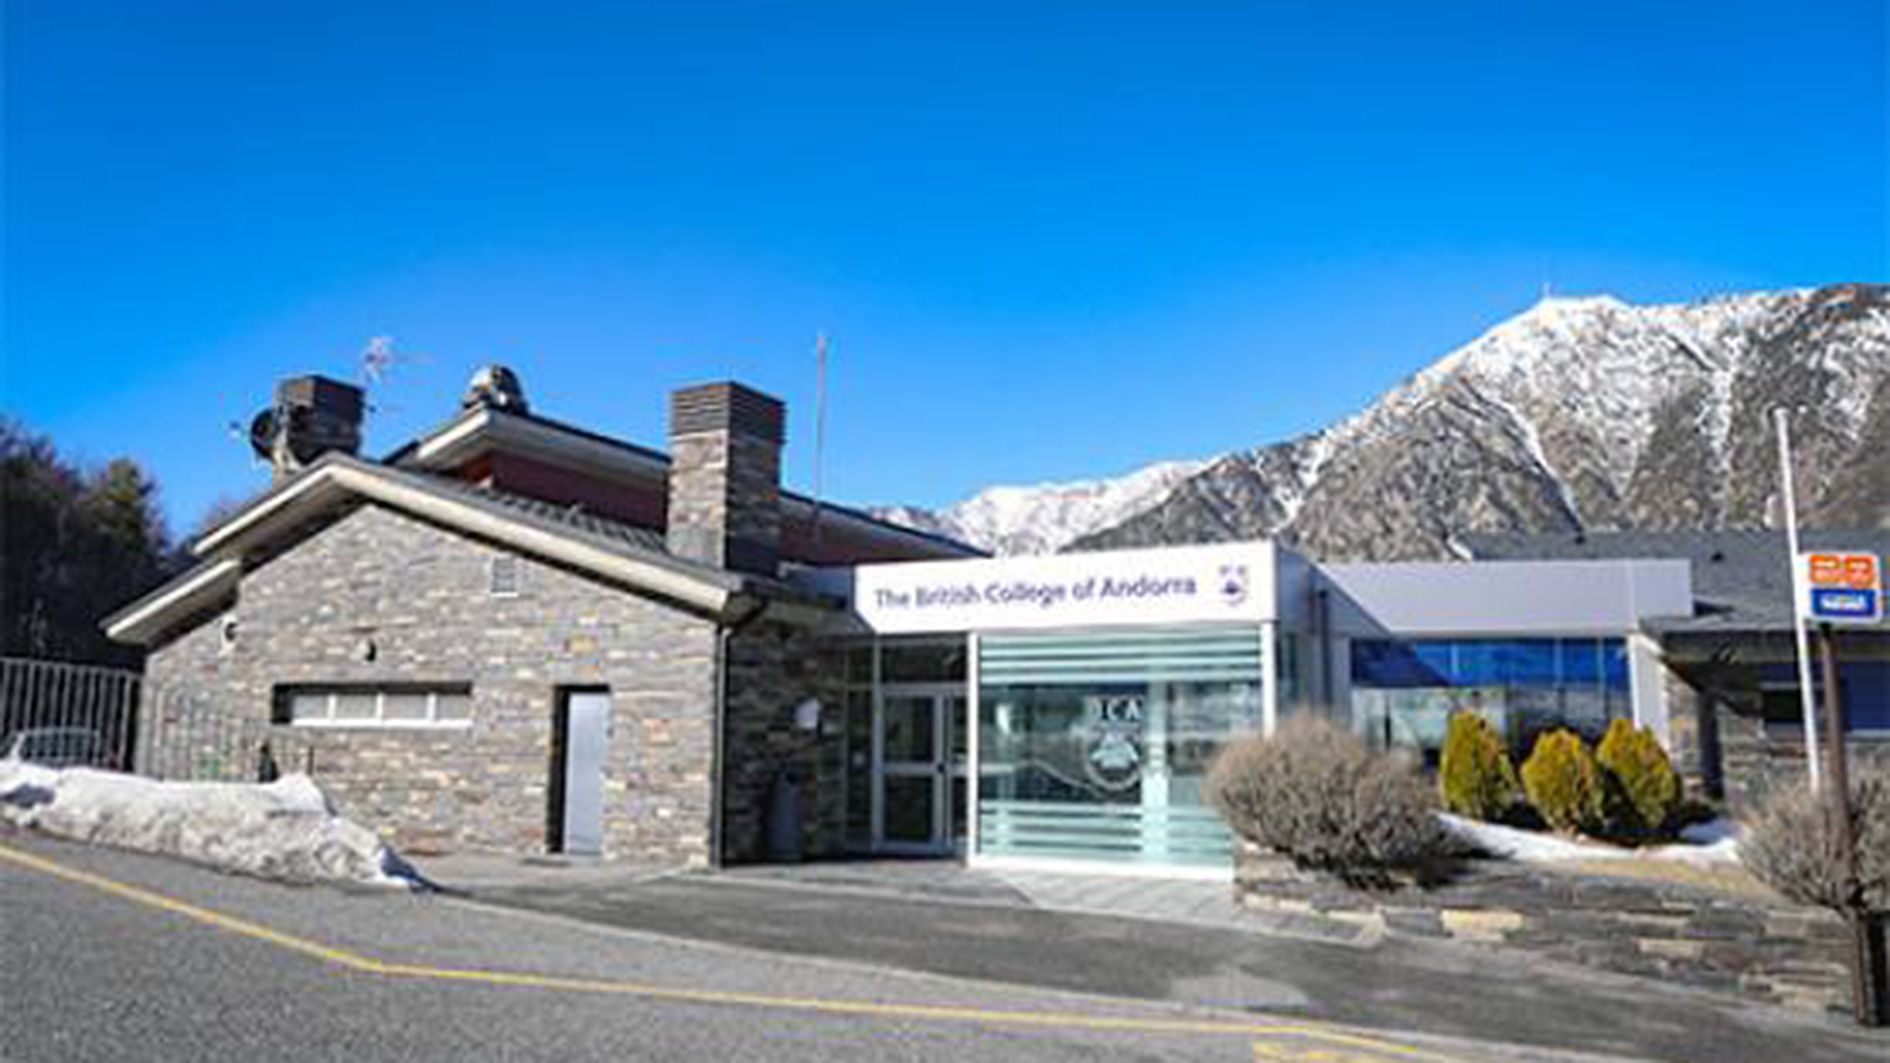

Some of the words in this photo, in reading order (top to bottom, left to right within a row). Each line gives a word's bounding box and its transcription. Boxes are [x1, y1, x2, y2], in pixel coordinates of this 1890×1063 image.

[875, 587, 910, 607] The
[915, 584, 981, 609] British
[985, 582, 1065, 608] College
[1072, 577, 1095, 600] of
[1100, 574, 1196, 598] Andorra
